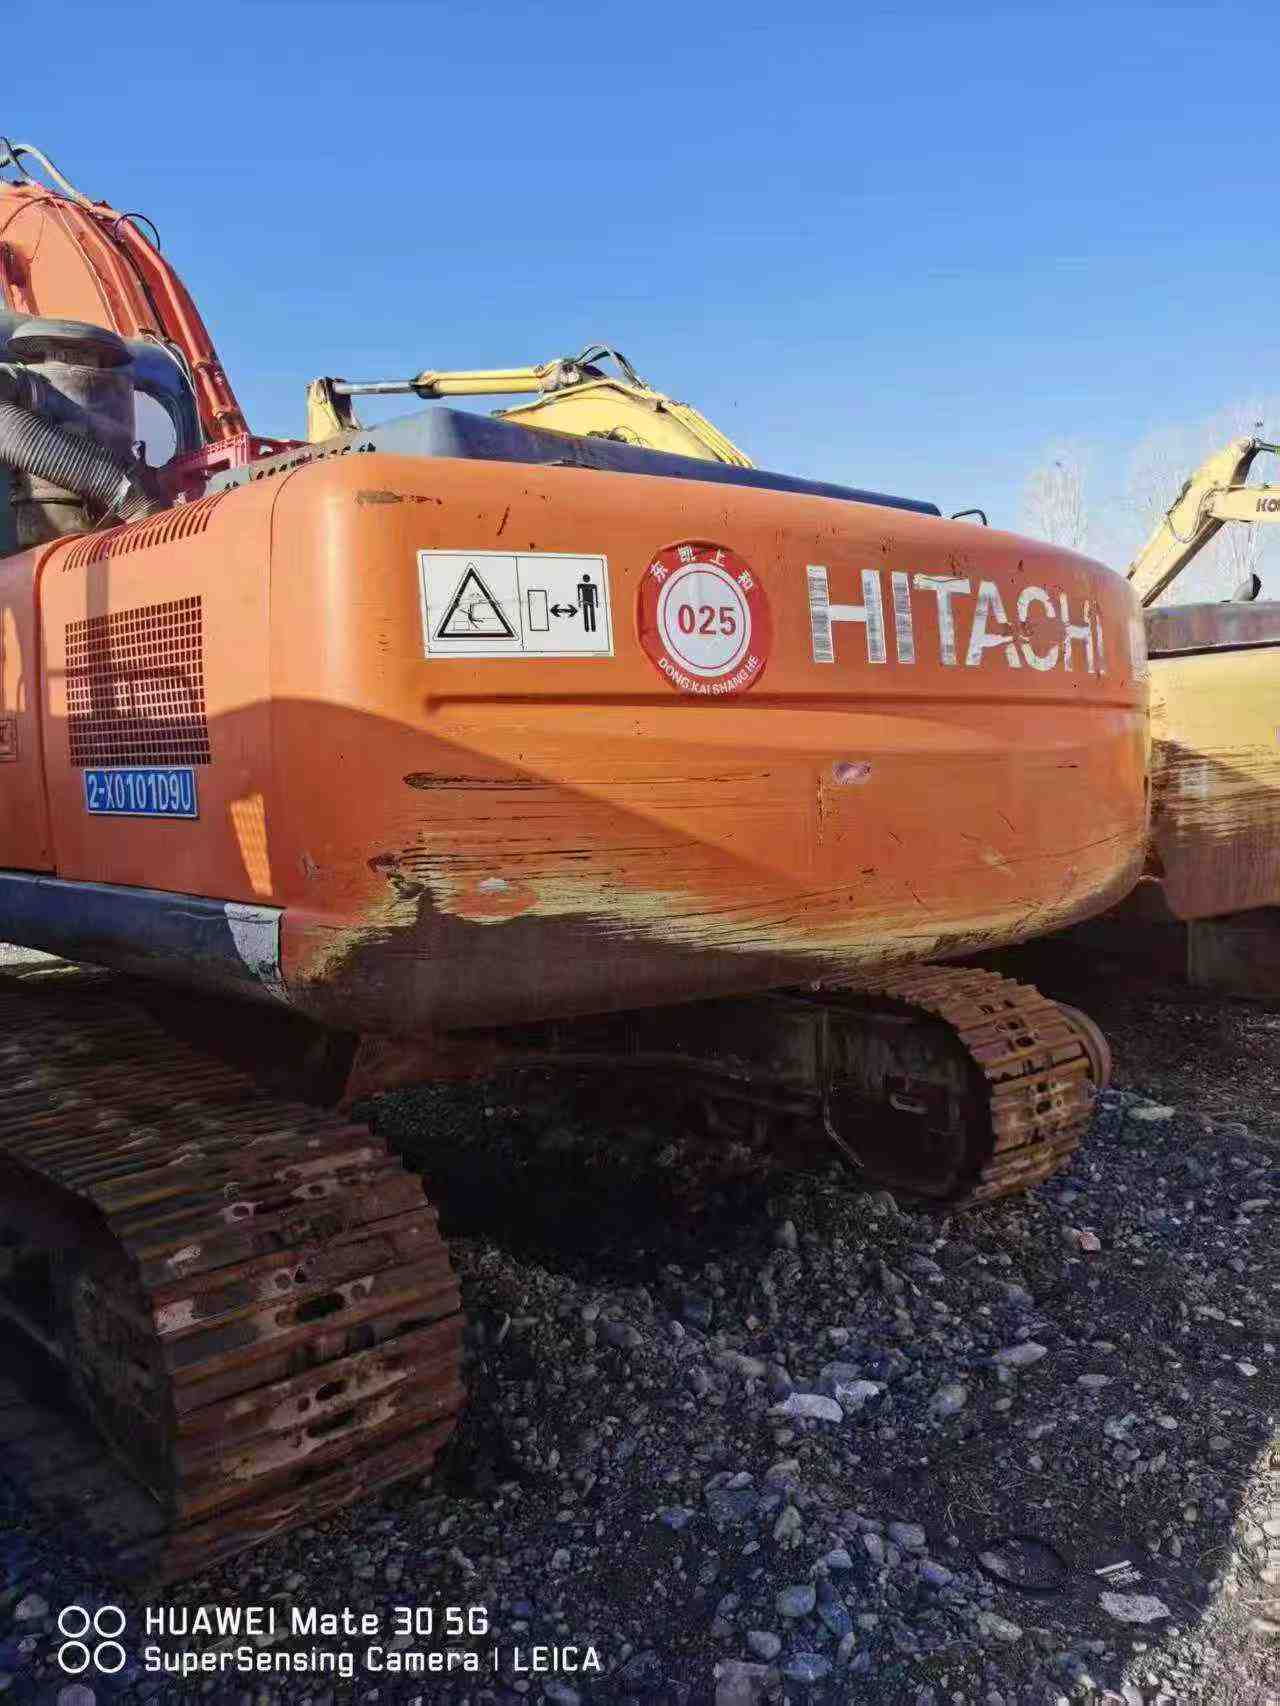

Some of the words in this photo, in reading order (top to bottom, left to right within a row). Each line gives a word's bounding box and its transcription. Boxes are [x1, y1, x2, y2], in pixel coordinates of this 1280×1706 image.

[677, 603, 737, 636] 025
[806, 564, 1105, 676] HITACHI
[691, 681, 710, 695] KAI
